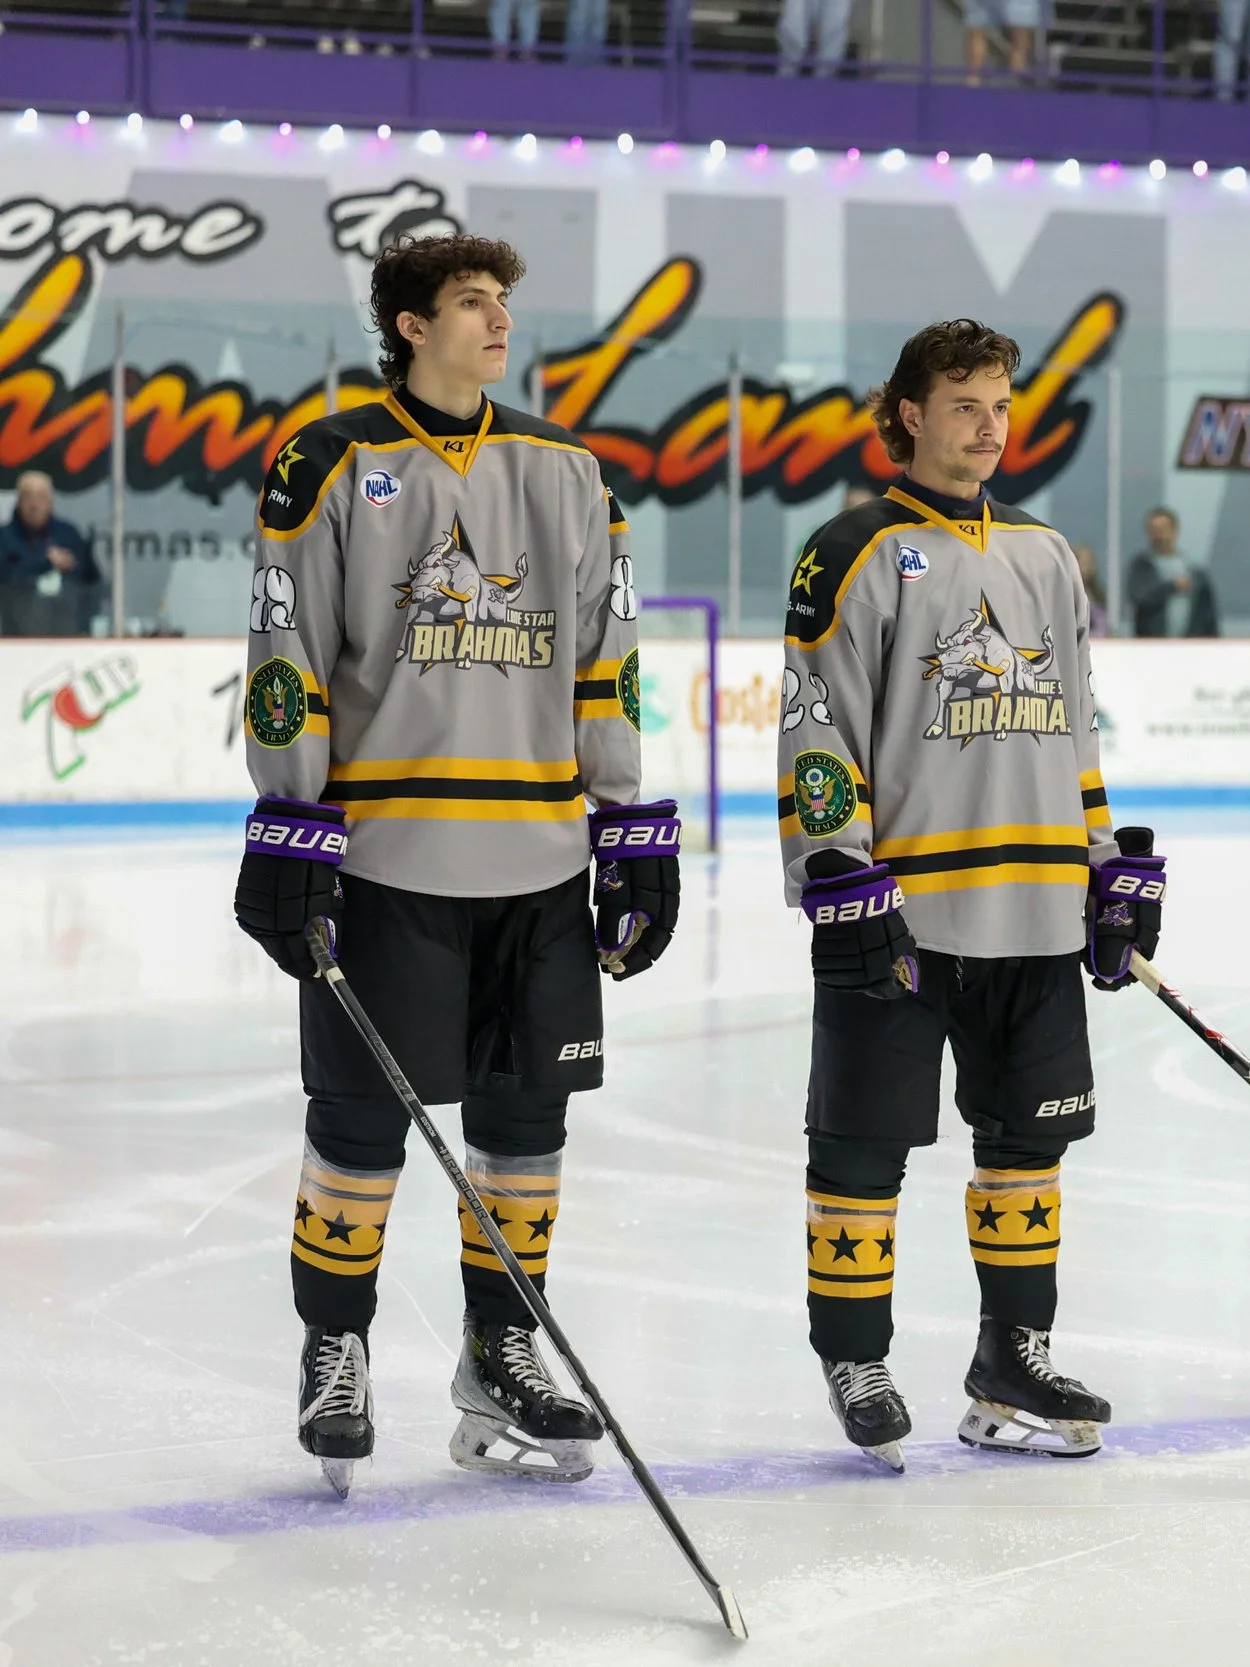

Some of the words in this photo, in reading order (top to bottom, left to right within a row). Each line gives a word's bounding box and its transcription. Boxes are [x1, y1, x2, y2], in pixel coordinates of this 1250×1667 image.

[528, 256, 1120, 500] Land
[365, 479, 398, 498] NAHL
[610, 555, 637, 622] 8
[524, 611, 556, 627] STAR
[796, 602, 816, 618] ARMY
[409, 624, 555, 667] BRAHMAS
[816, 756, 847, 780] STATES
[808, 820, 838, 833] ARMY
